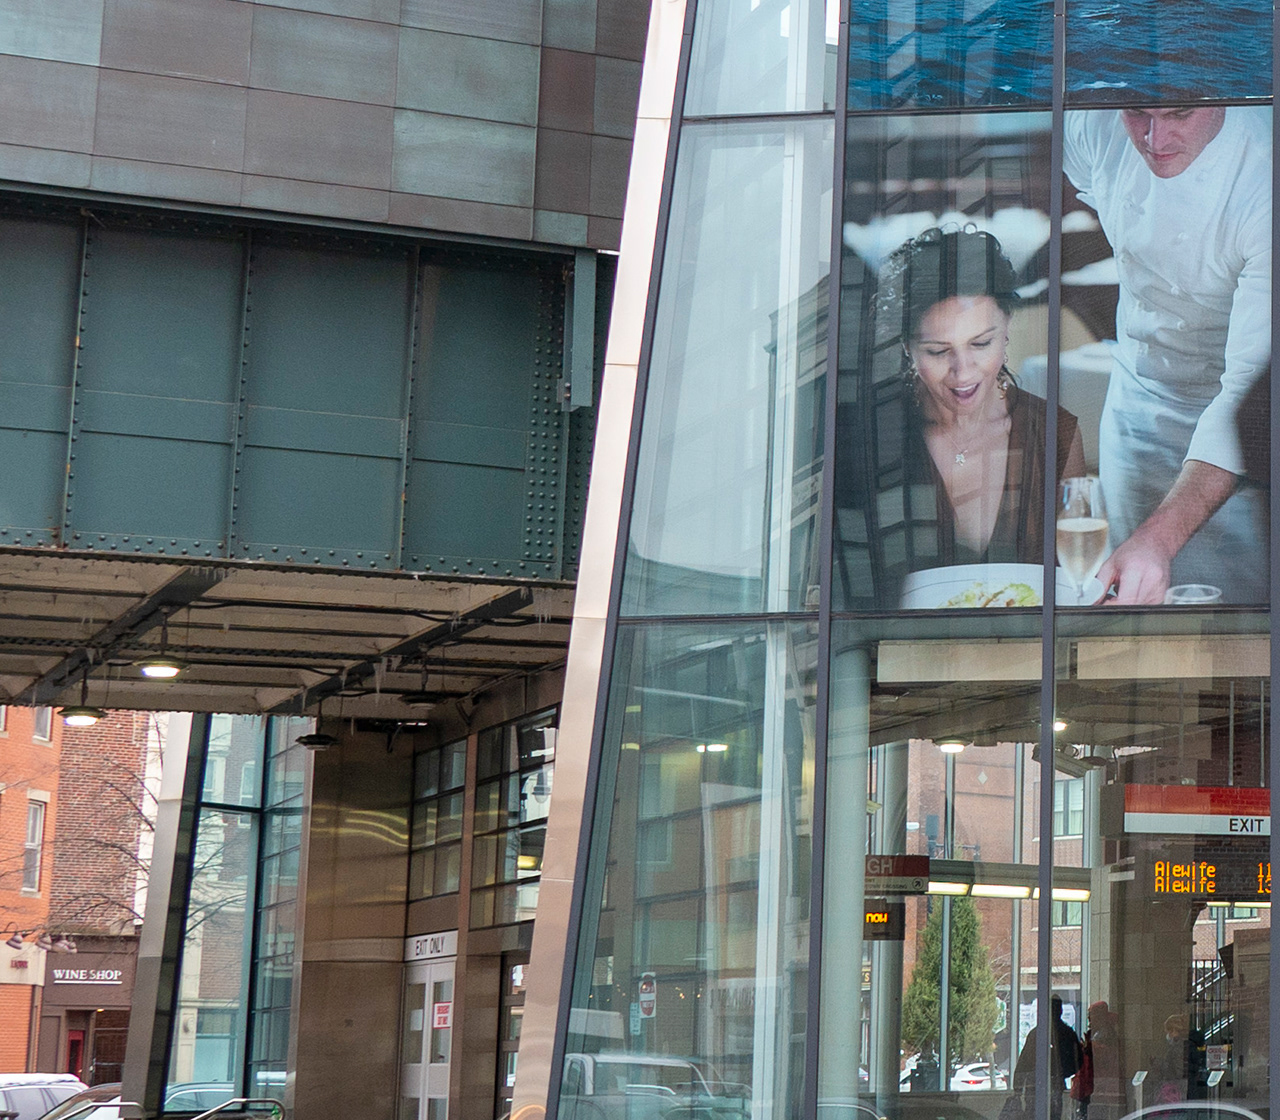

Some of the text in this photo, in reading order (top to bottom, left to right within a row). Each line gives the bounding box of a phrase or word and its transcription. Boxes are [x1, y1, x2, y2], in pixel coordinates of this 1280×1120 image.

[1229, 818, 1265, 833] EXIT
[1154, 861, 1217, 879] Alewife
[1154, 877, 1217, 893] Alewife
[865, 912, 888, 923] now
[53, 968, 122, 980] WINE SHOP
